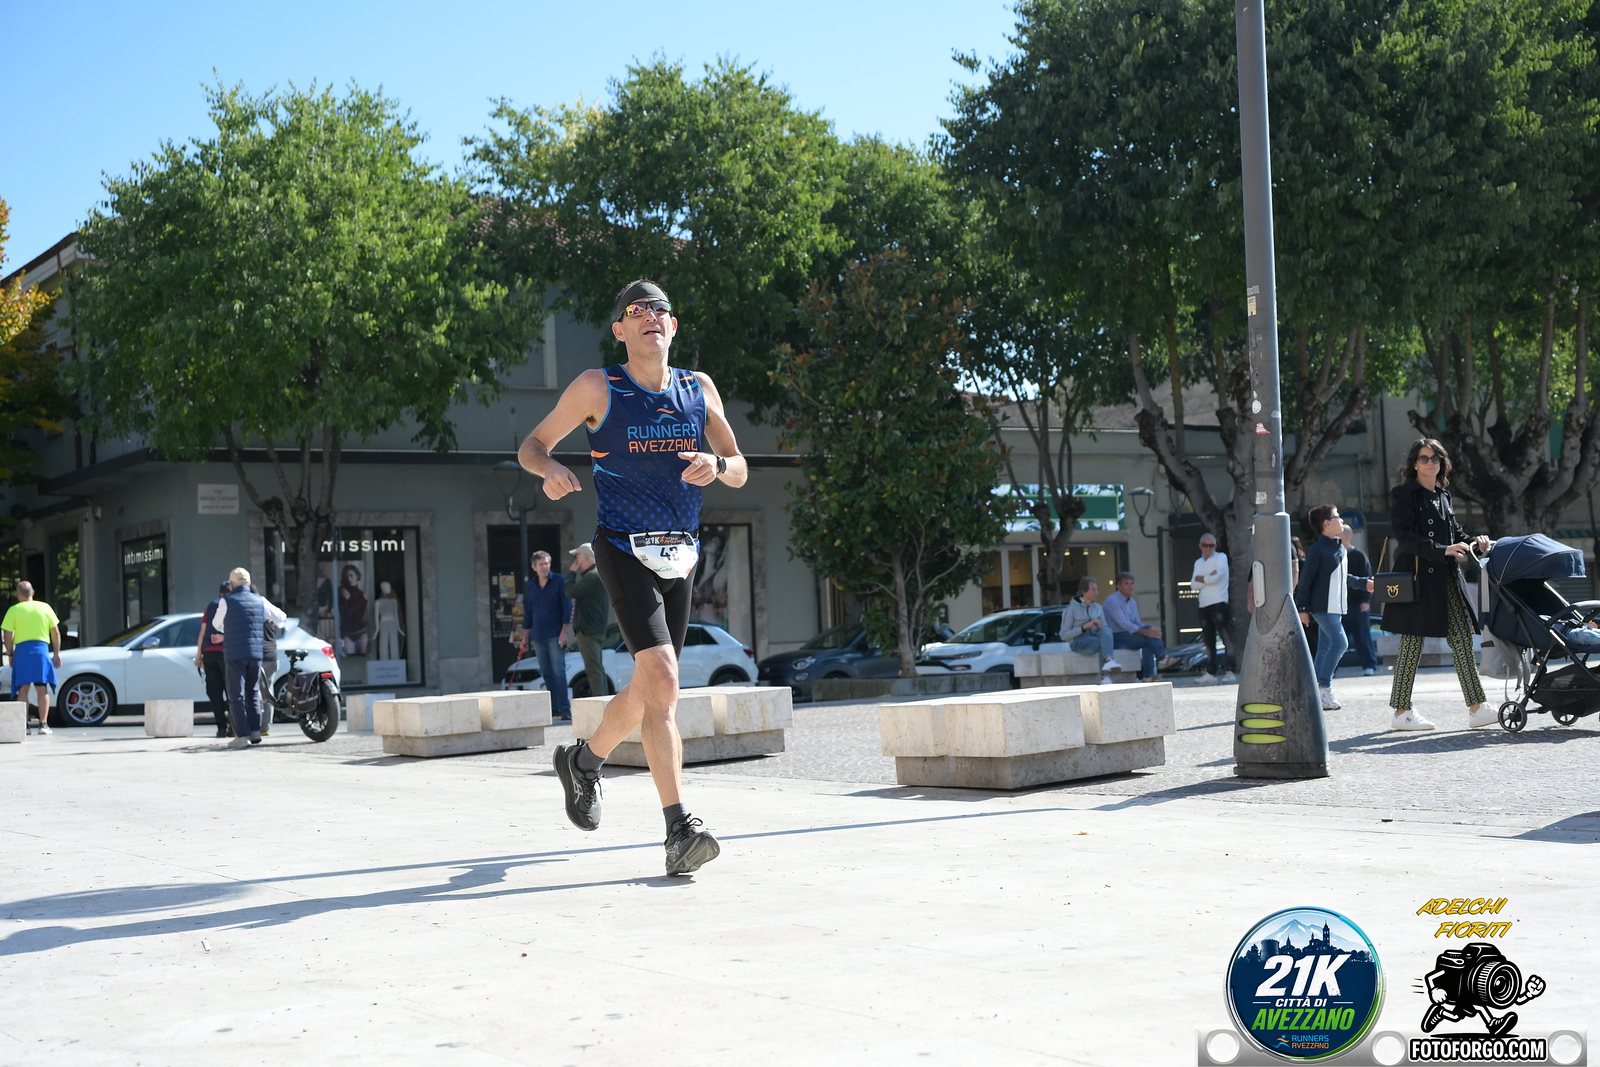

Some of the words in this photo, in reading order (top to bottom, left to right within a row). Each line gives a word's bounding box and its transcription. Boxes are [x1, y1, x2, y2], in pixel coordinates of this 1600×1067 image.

[627, 423, 697, 439] RUNNERS
[281, 539, 405, 553] imissimi
[124, 548, 163, 566] intimissimi
